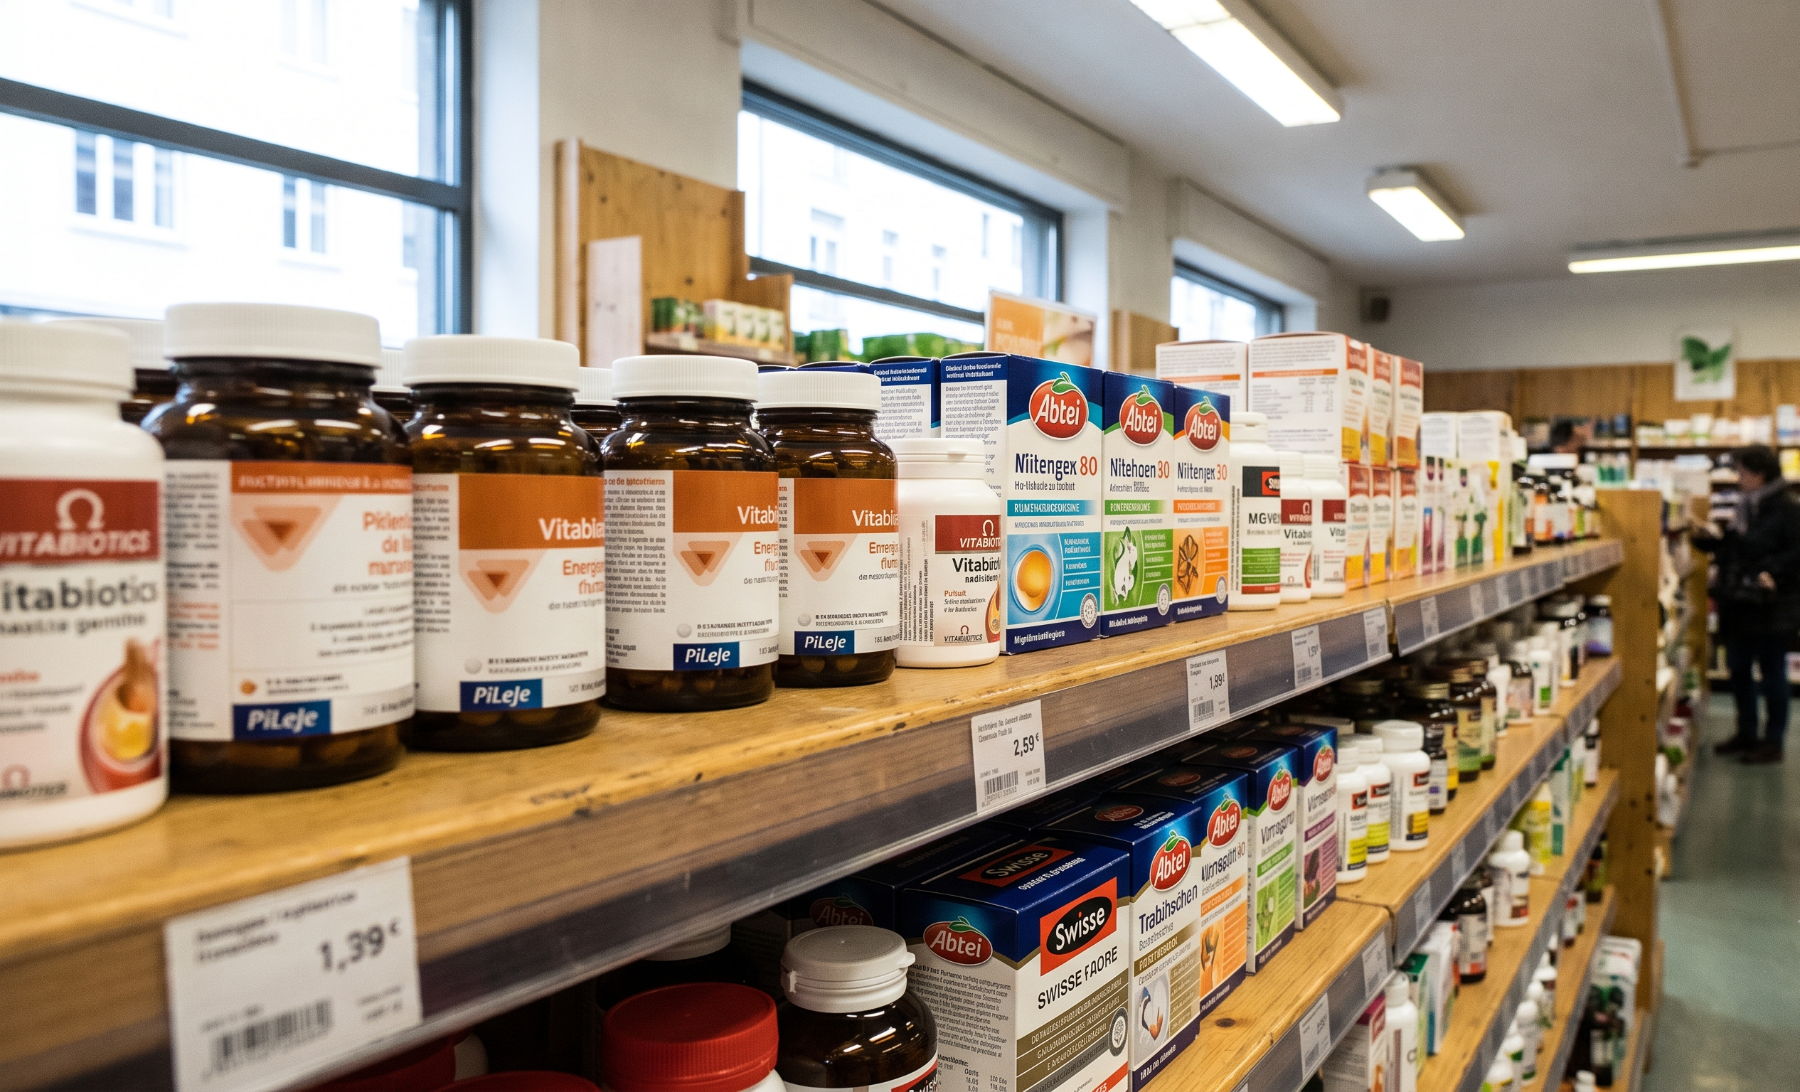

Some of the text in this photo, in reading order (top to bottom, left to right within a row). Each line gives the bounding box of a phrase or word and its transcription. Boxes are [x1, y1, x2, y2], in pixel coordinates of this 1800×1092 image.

[1034, 393, 1081, 427] Abtei
[1123, 404, 1157, 433] Abtei
[1187, 414, 1218, 441] Abtei
[1080, 455, 1098, 476] 80
[1158, 460, 1170, 479] 30
[1217, 464, 1228, 480] 30
[1210, 805, 1239, 844] Abtei
[985, 850, 1049, 877] Swisse
[1154, 848, 1187, 887] Abtei
[1054, 906, 1106, 951] Swisse
[930, 929, 983, 959] Abtei
[1037, 969, 1083, 1010] SWISSE
